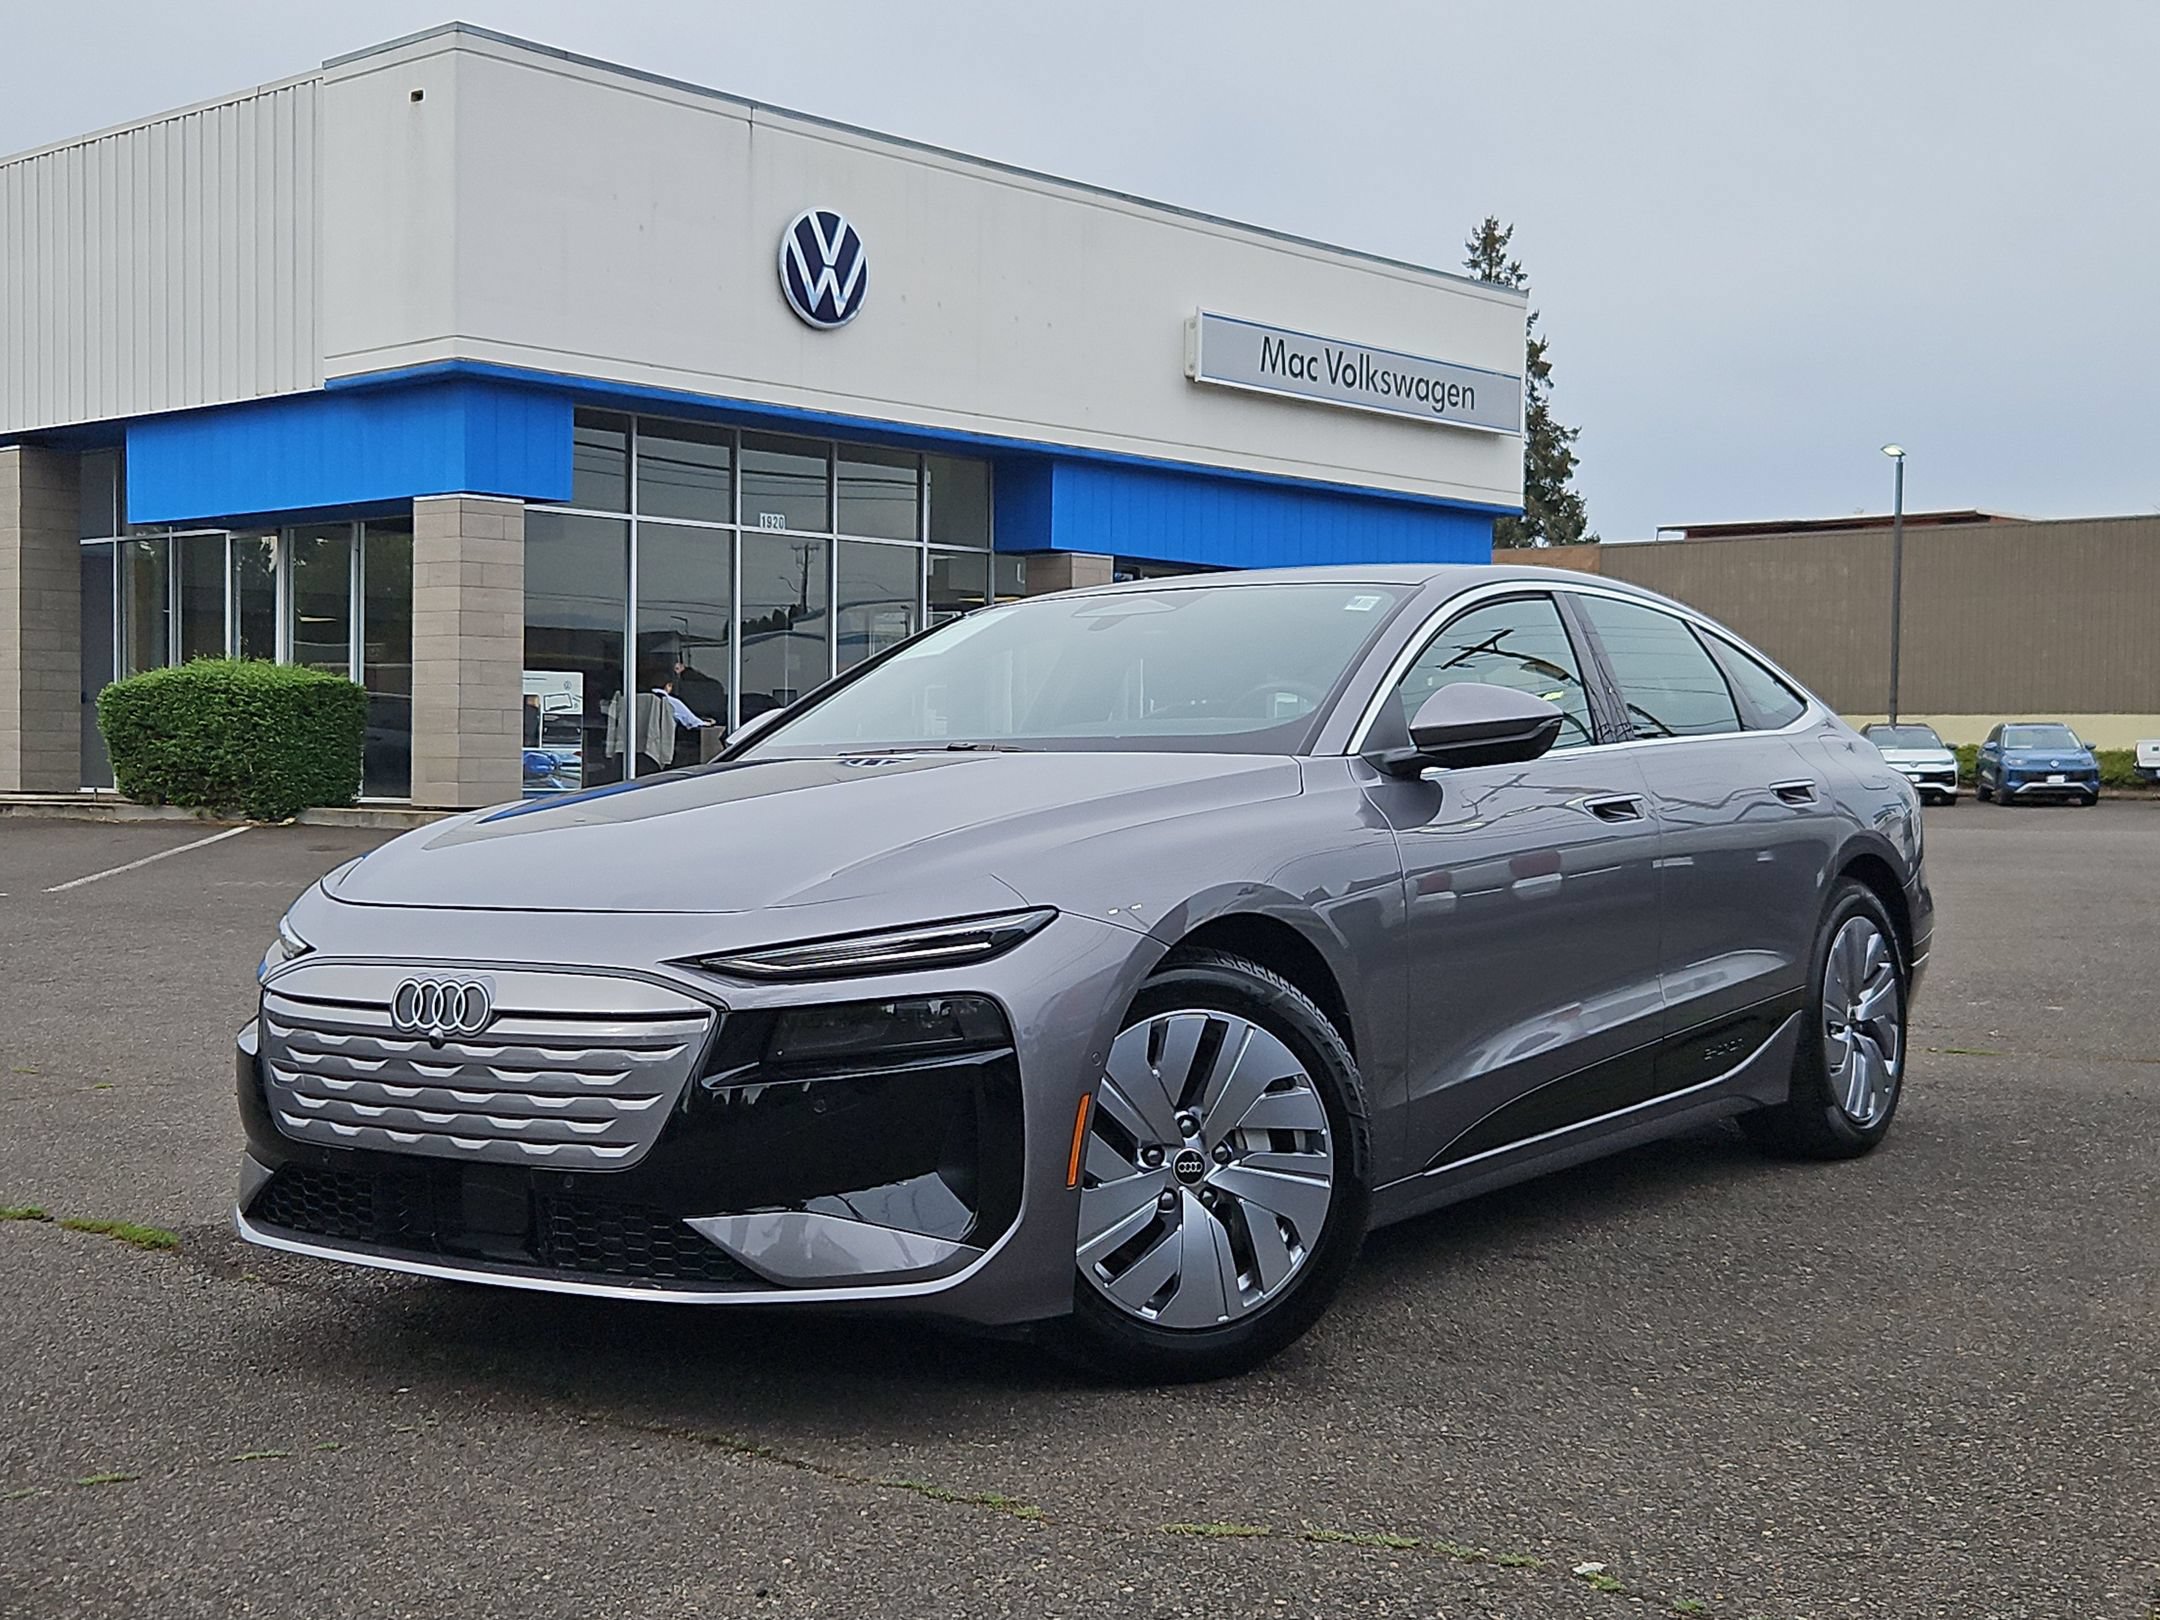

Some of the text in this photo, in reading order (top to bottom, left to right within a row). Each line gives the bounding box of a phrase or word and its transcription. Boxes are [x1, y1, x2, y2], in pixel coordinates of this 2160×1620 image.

[1260, 336, 1476, 413] Mac Volkswagen
[761, 515, 785, 530] 1920
